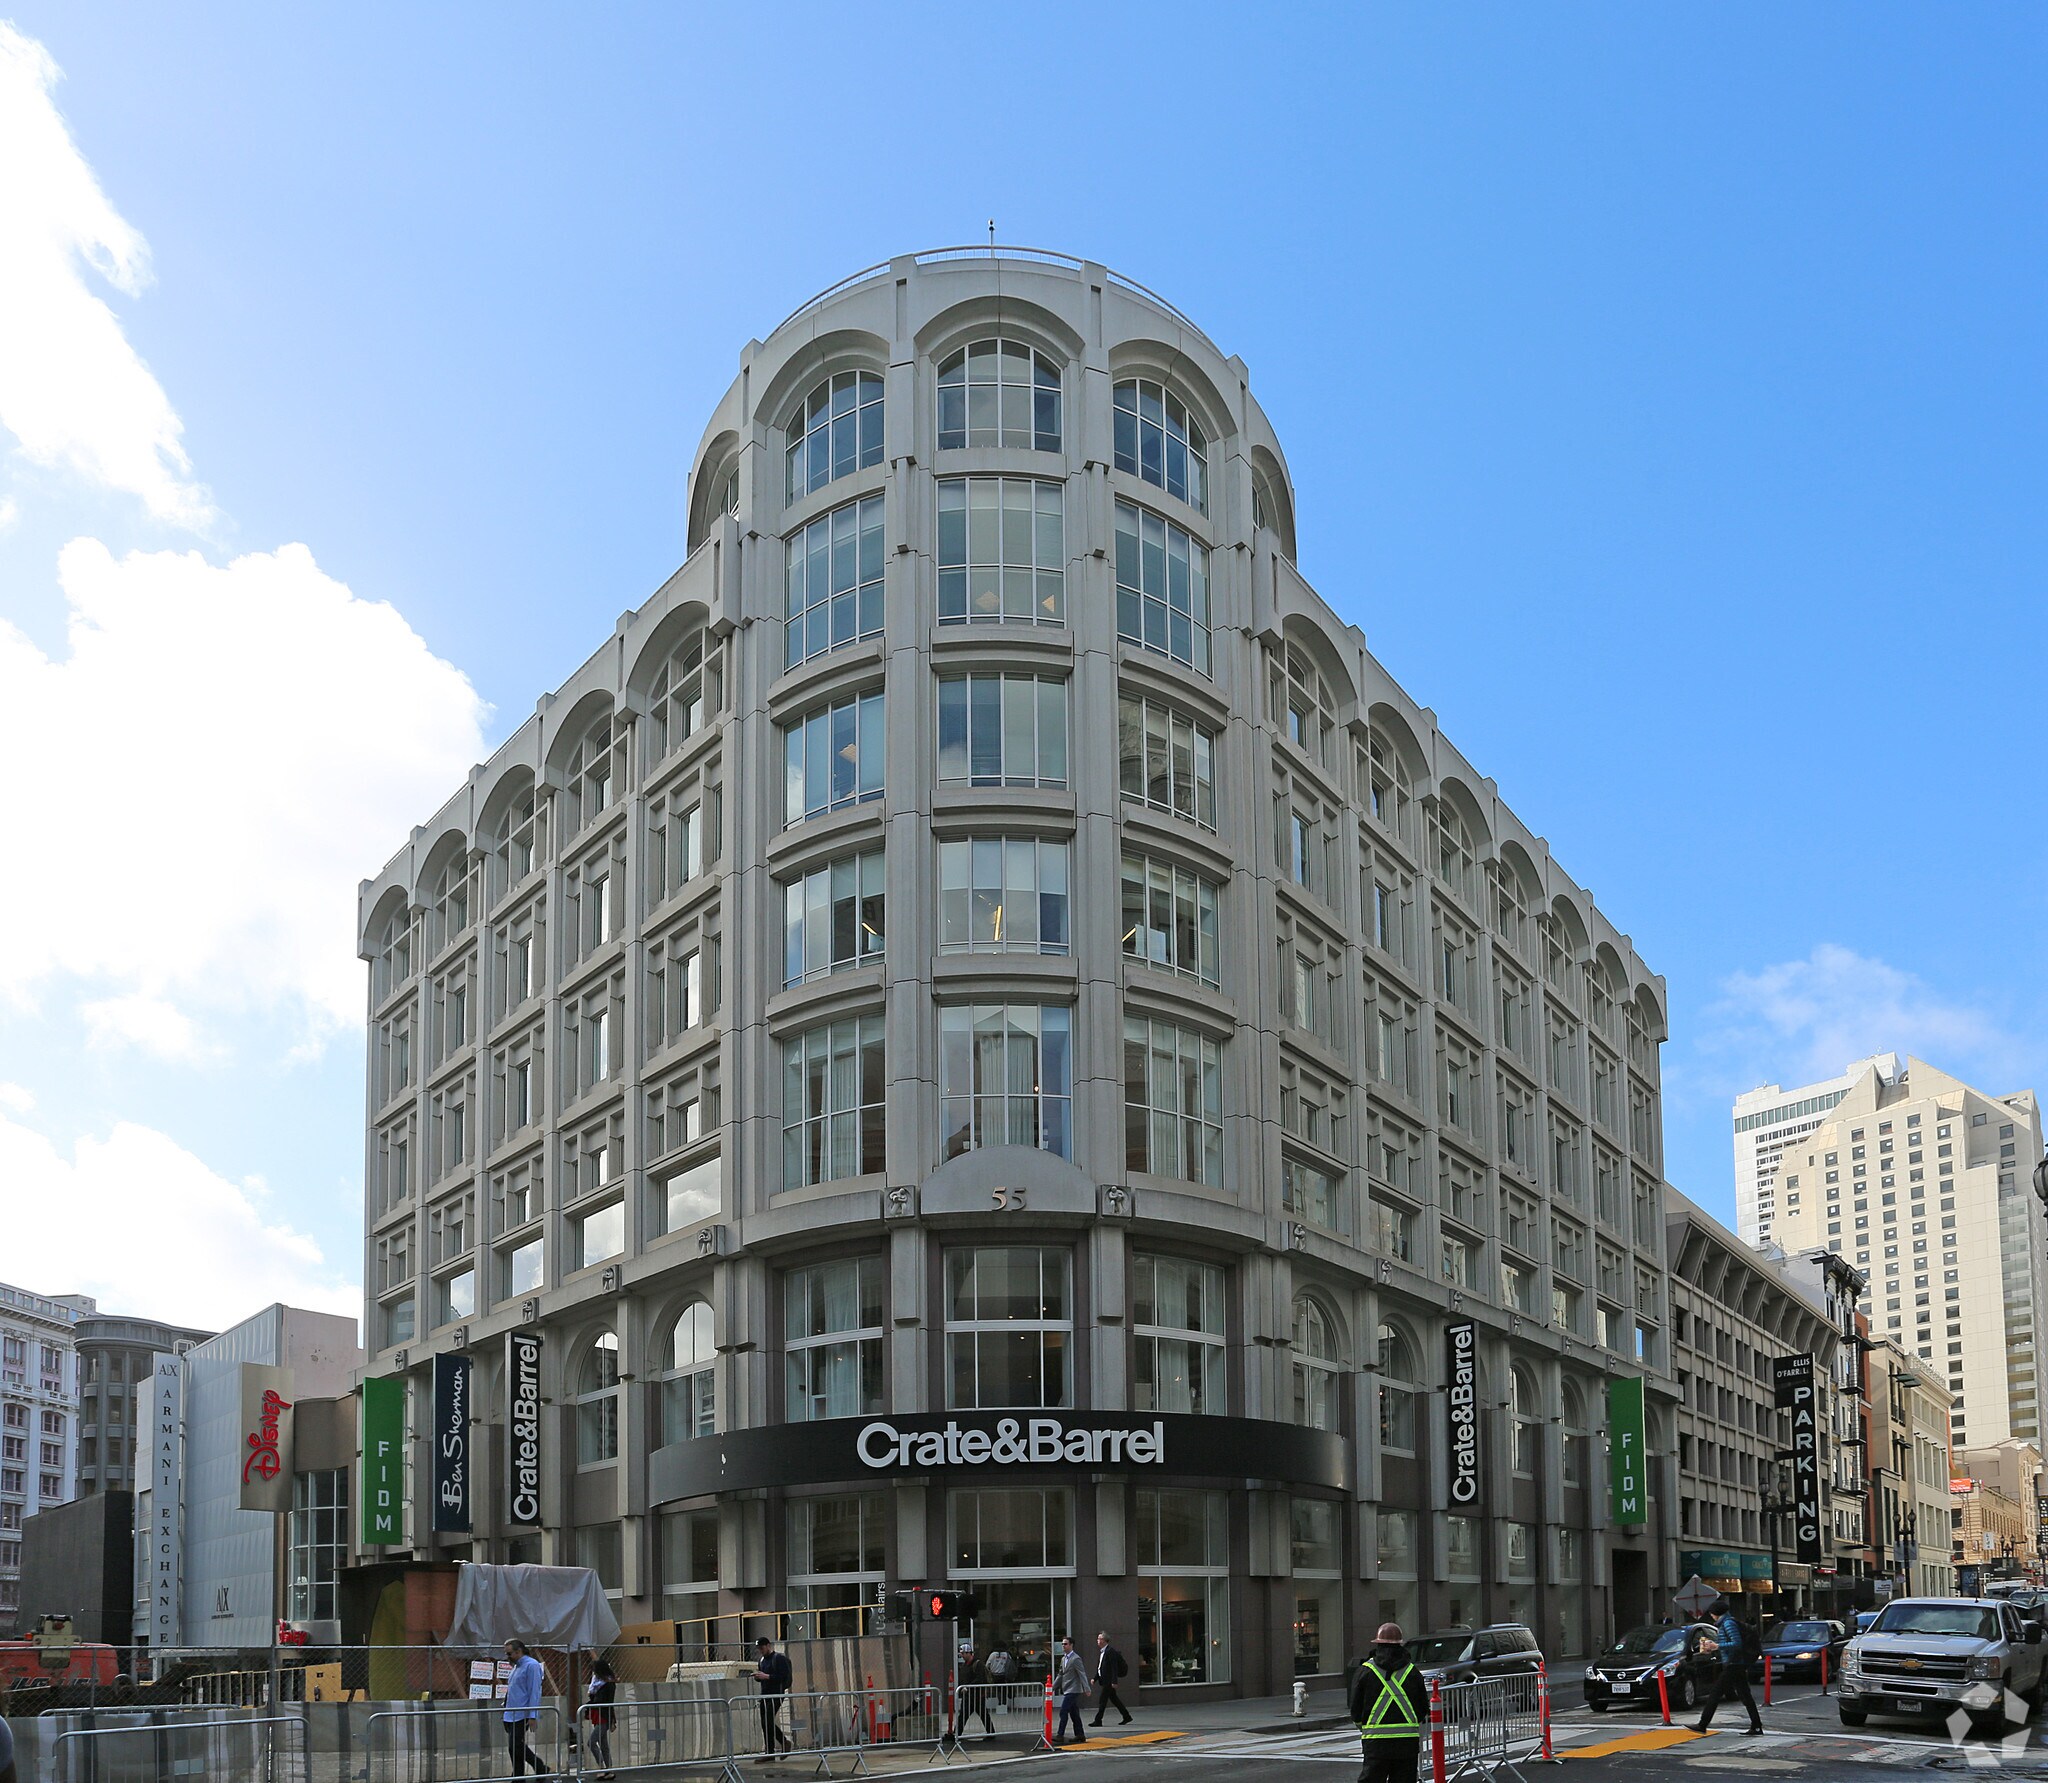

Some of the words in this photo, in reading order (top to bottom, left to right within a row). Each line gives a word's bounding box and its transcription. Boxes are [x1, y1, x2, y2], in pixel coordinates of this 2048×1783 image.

[992, 1186, 1026, 1211] 55
[1776, 1367, 1809, 1378] O'FARRL
[1793, 1358, 1810, 1367] ELLIS
[161, 1389, 173, 1486] ARMANI
[442, 1366, 463, 1460] Sherman
[513, 1336, 538, 1521] Crate&Barrel
[856, 1418, 1164, 1468] Crate&Barrel
[1450, 1324, 1476, 1502] Crate&Barrel
[376, 1440, 392, 1532] FIDM
[441, 1461, 463, 1514] Ben
[1622, 1433, 1636, 1513] FIDM
[1794, 1386, 1817, 1542] PARKING
[159, 1508, 171, 1643] EXCHANGE
[876, 1582, 886, 1630] Upsairs
